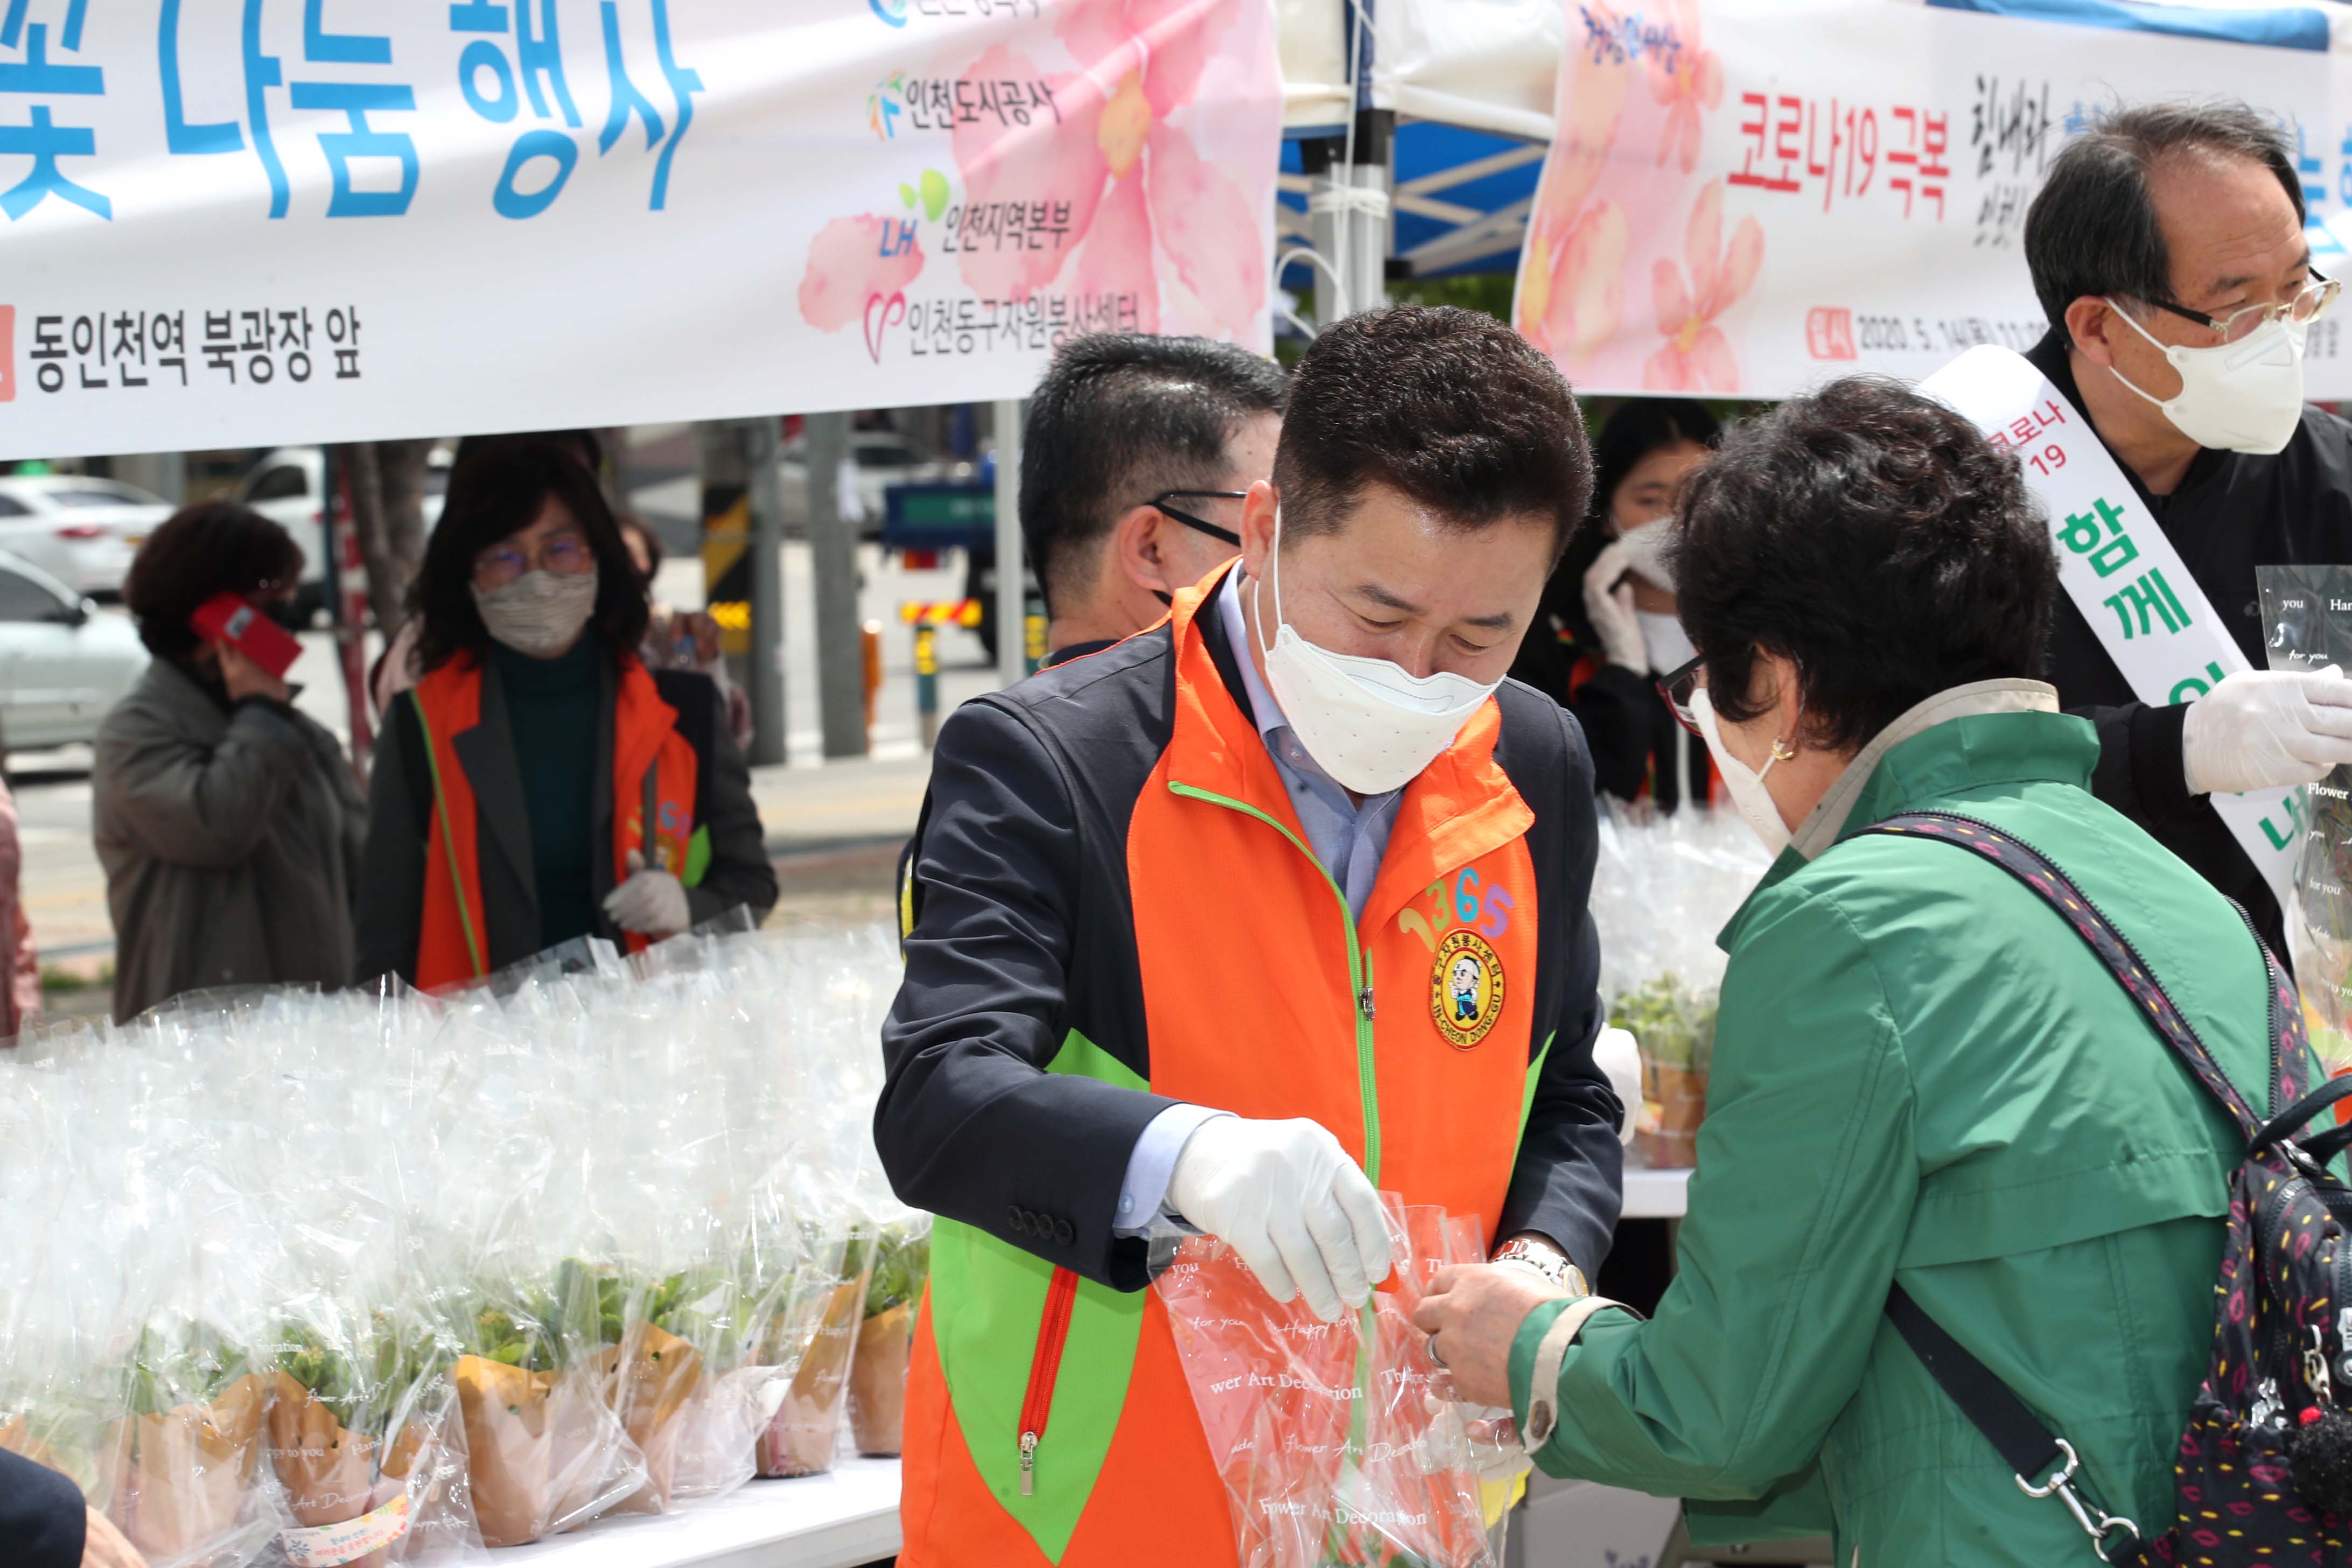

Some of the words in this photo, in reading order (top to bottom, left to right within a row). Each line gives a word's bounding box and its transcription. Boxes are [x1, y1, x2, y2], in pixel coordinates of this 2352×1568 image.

[159, 0, 419, 219] 나눔
[449, 0, 705, 220] 행사
[905, 79, 1063, 129] 인천도시공사
[1727, 92, 1878, 214] 코로나19
[1886, 106, 1950, 223] 극복
[942, 201, 1071, 253] 인천지역본부
[879, 219, 918, 257] LH
[30, 310, 188, 393] 동인천역
[201, 307, 312, 386] 북광장
[326, 305, 361, 379] 앞
[2029, 444, 2067, 476] 19
[2283, 599, 2304, 611] you
[2307, 653, 2328, 665] you
[2307, 782, 2349, 800] Flower
[2321, 883, 2341, 896] you
[1172, 1262, 1200, 1278] you
[1275, 1319, 1330, 1341] Happy
[1248, 1373, 1276, 1388] Art
[300, 1447, 325, 1460] you
[1335, 1507, 1427, 1526] Decoration
